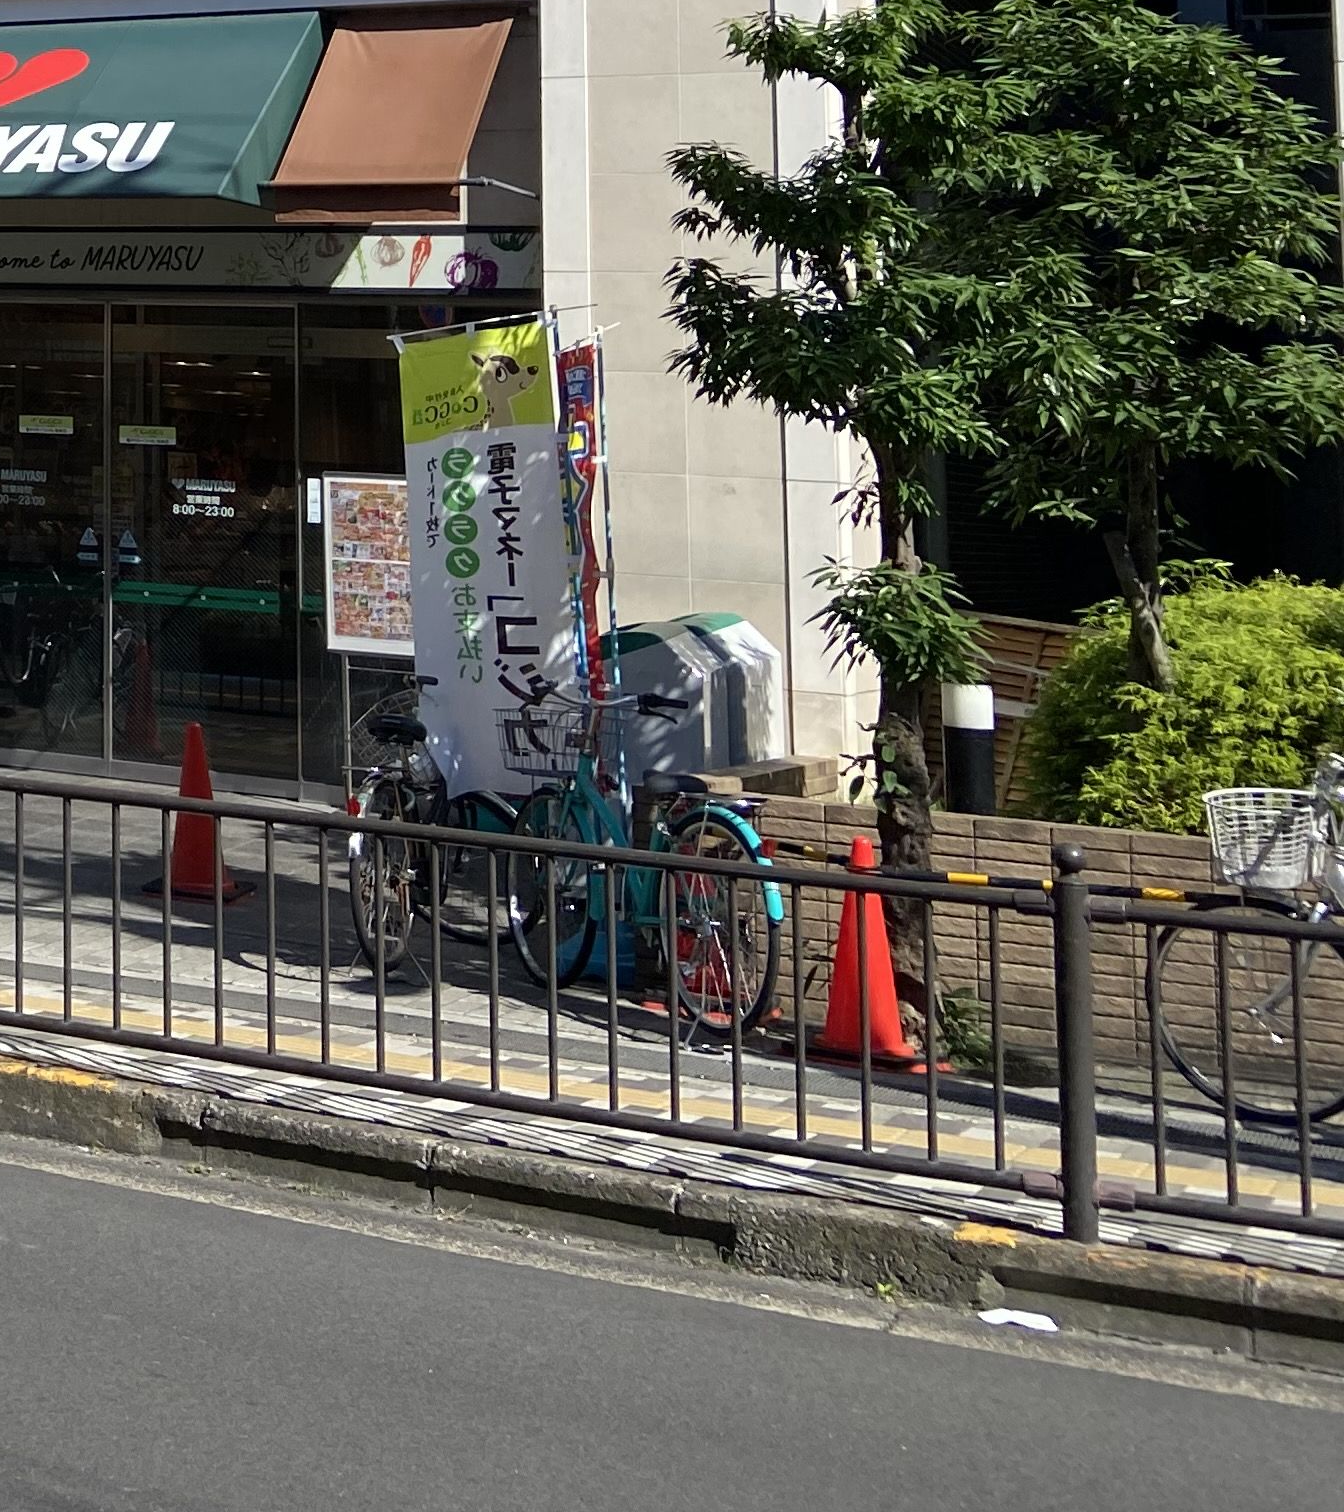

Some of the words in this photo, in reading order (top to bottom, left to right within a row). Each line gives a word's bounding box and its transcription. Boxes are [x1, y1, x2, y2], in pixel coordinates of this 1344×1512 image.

[49, 248, 76, 270] to
[80, 244, 205, 272] MARUYASU
[0, 468, 47, 483] MARUYASU
[185, 478, 237, 493] MARUYASU
